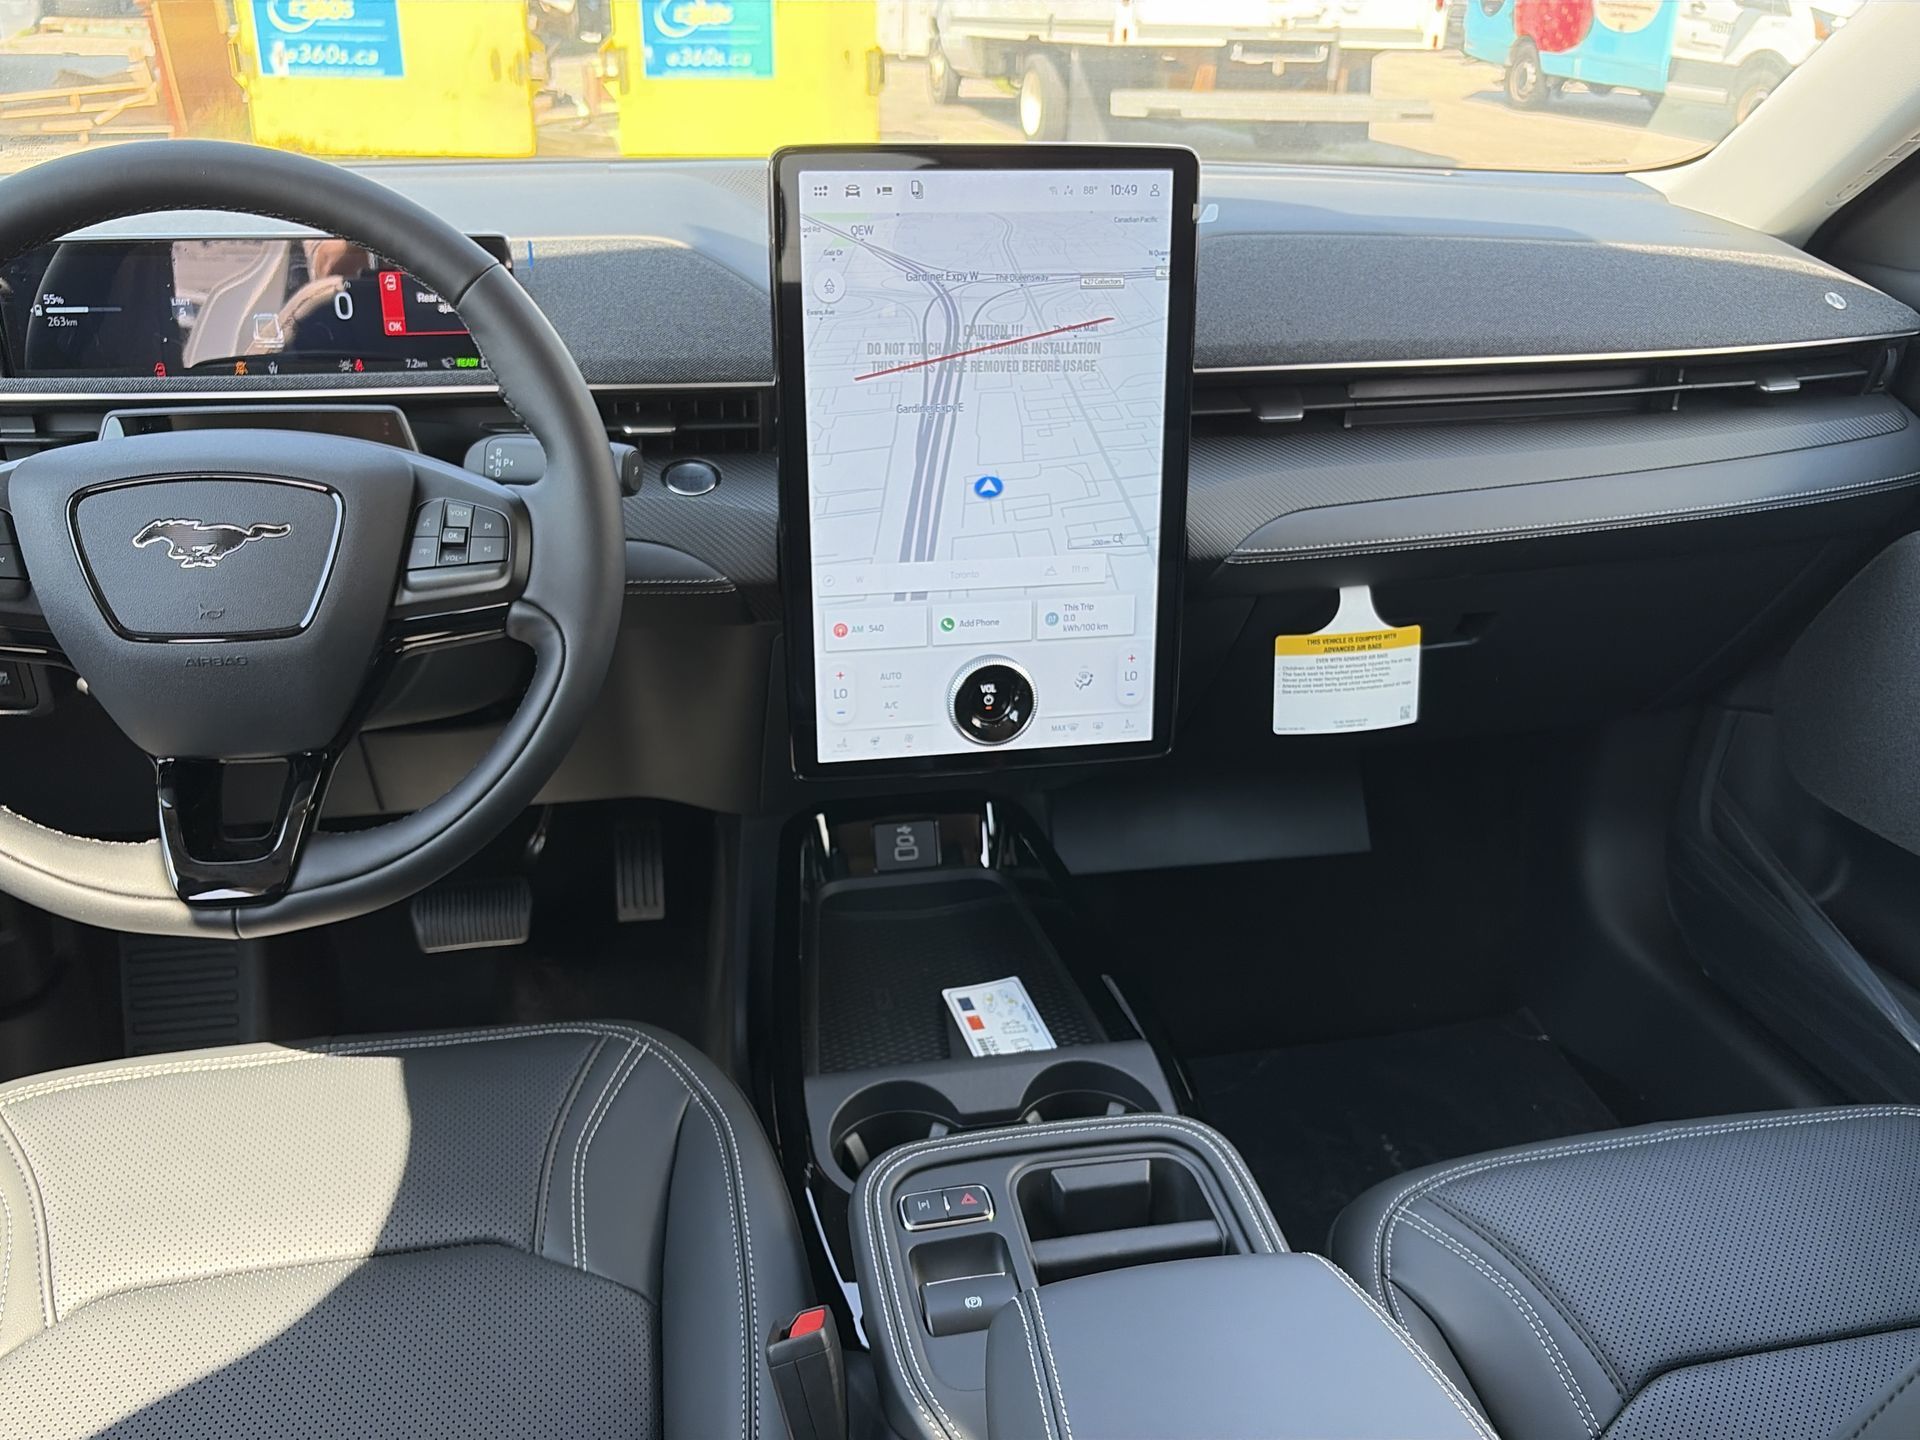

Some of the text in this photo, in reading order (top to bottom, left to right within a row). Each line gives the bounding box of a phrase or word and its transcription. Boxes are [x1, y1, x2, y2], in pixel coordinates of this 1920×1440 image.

[1110, 184, 1138, 196] 10:49
[850, 225, 874, 237] QEW
[905, 271, 979, 283] Gardiner Expy W
[995, 273, 1049, 282] The Queensway
[43, 294, 64, 305] 55%
[416, 292, 438, 303] Rear
[334, 291, 353, 320] 0
[388, 321, 403, 332] OK
[964, 324, 1009, 337] CAUTION
[866, 343, 882, 356] DO
[884, 342, 906, 355] NOT
[1031, 341, 1101, 355] INSTALLATION
[456, 358, 479, 367] READY
[970, 360, 1019, 373] REMOVED
[1022, 360, 1060, 372] BEFORE
[1062, 359, 1096, 372] USAGE
[896, 402, 964, 415] Gardiner Expy E
[496, 448, 503, 457] R
[495, 459, 502, 467] N
[495, 469, 501, 477] D
[950, 570, 980, 580] Toronto
[1064, 603, 1094, 613] This Trip
[1063, 614, 1076, 622] 0.0
[959, 619, 1000, 628] Add Phone
[1063, 623, 1109, 632] kWh/100 km
[868, 625, 884, 633] 540
[1355, 634, 1382, 643] EQUIPPED
[184, 655, 248, 668] AIRBAG
[880, 672, 902, 681] AUTO
[1124, 670, 1138, 681] LO
[980, 684, 997, 693] VOL
[833, 689, 848, 699] LO
[884, 701, 899, 709] A/C
